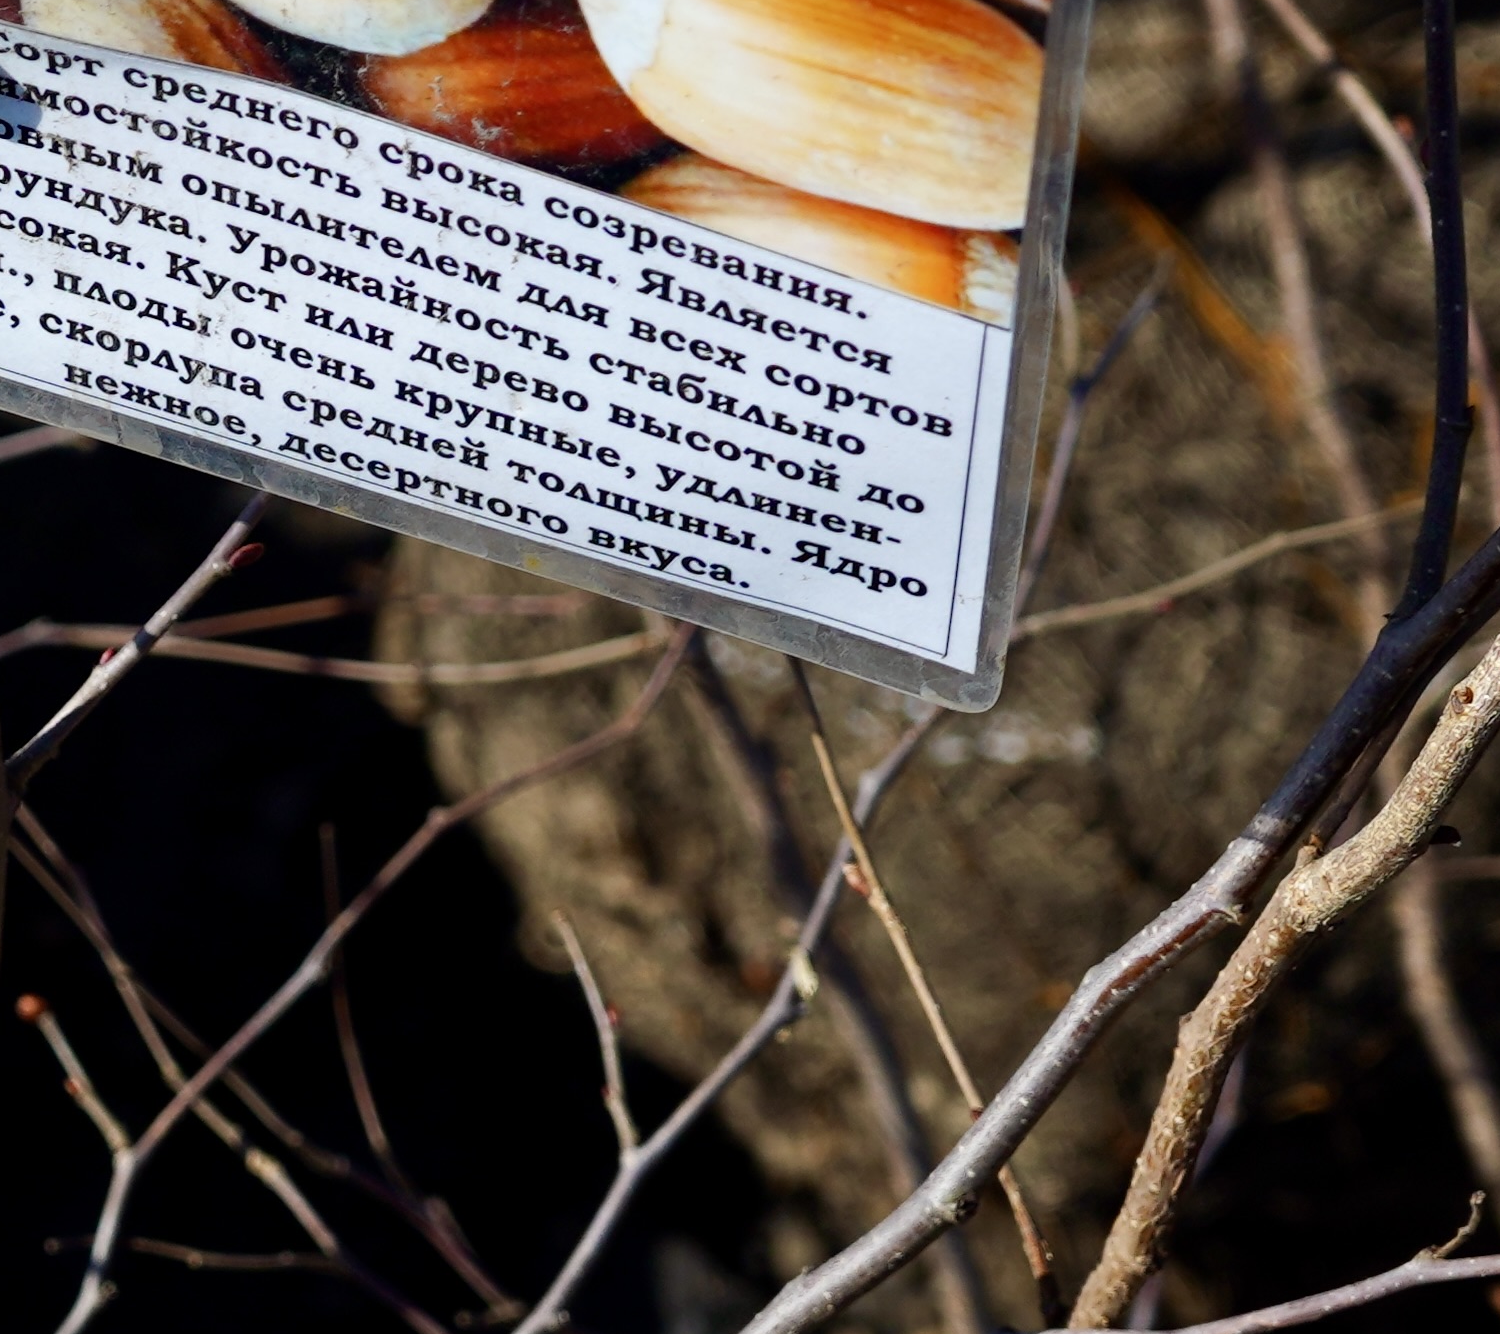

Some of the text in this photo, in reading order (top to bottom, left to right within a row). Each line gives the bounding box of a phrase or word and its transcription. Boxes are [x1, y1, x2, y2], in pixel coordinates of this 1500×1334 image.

[123, 67, 359, 151] среднего
[379, 141, 523, 205] срока
[544, 196, 868, 319] созревания.
[181, 173, 501, 292] опылителем
[517, 281, 609, 328] для
[629, 315, 747, 374] всех
[765, 363, 954, 438] сортов
[381, 187, 618, 283] высокая.
[637, 267, 892, 375] Является
[39, 311, 264, 399] скорлупа
[282, 389, 488, 471] средней
[508, 459, 770, 554] толщины.
[791, 539, 927, 598] Ядро
[53, 269, 211, 336] плоды
[231, 327, 375, 390] очень
[395, 378, 636, 479] крупные,
[657, 463, 902, 547] удлинен-
[166, 250, 287, 313] Куст
[304, 302, 395, 350] или
[409, 340, 589, 411] дерево
[609, 403, 841, 493] высотой
[858, 481, 924, 516] до
[227, 224, 570, 361] Урожайность
[590, 351, 865, 455] стабильно
[65, 364, 751, 589] нежное, десертного вкуса.
